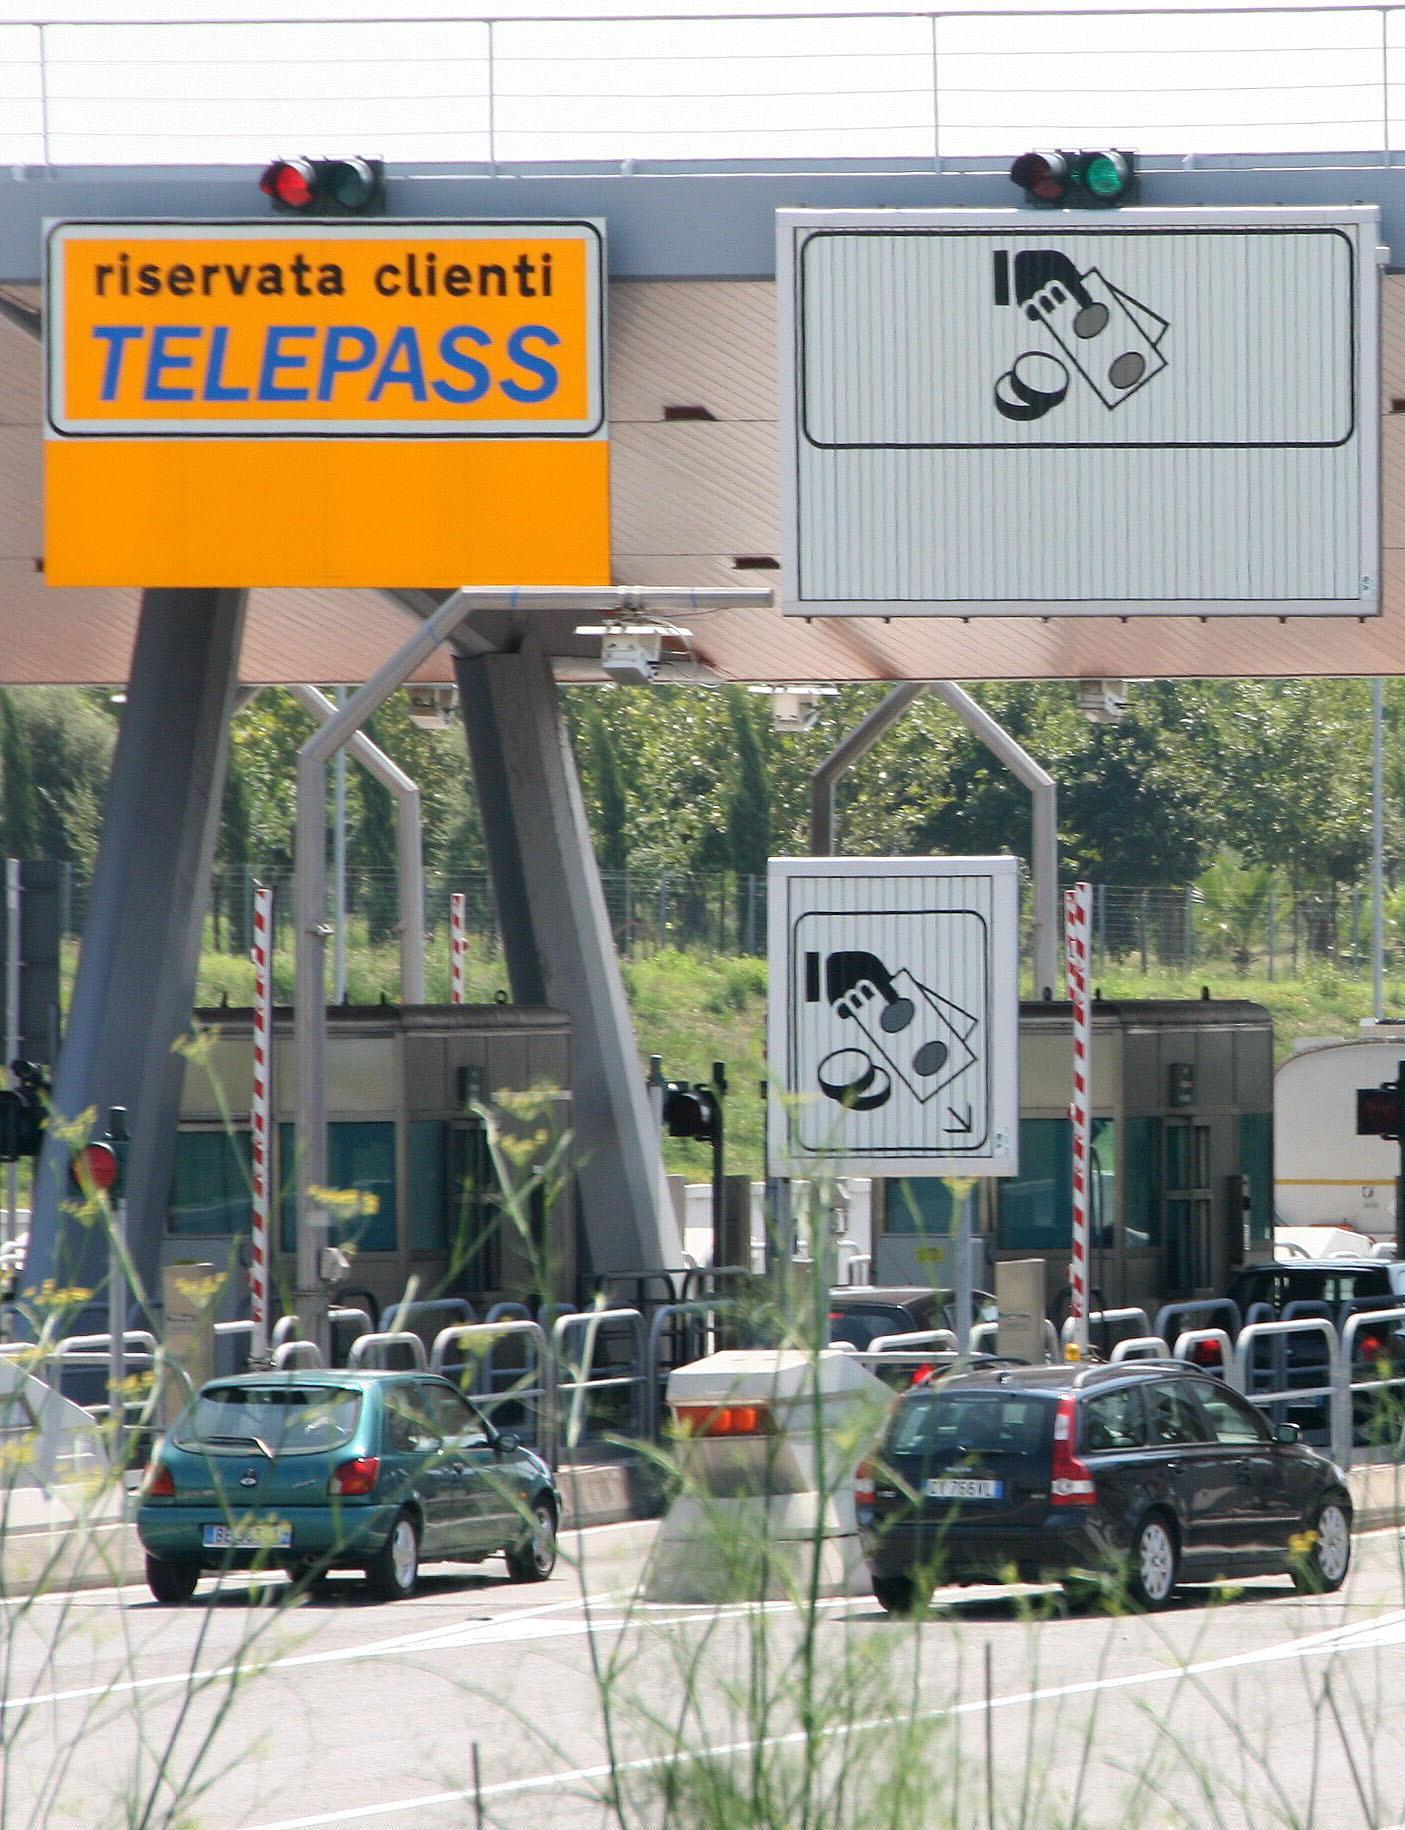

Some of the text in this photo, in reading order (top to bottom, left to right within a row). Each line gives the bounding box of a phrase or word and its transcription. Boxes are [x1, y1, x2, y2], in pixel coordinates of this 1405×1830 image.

[94, 252, 553, 298] riservata clienti
[92, 324, 561, 405] TELEPASS
